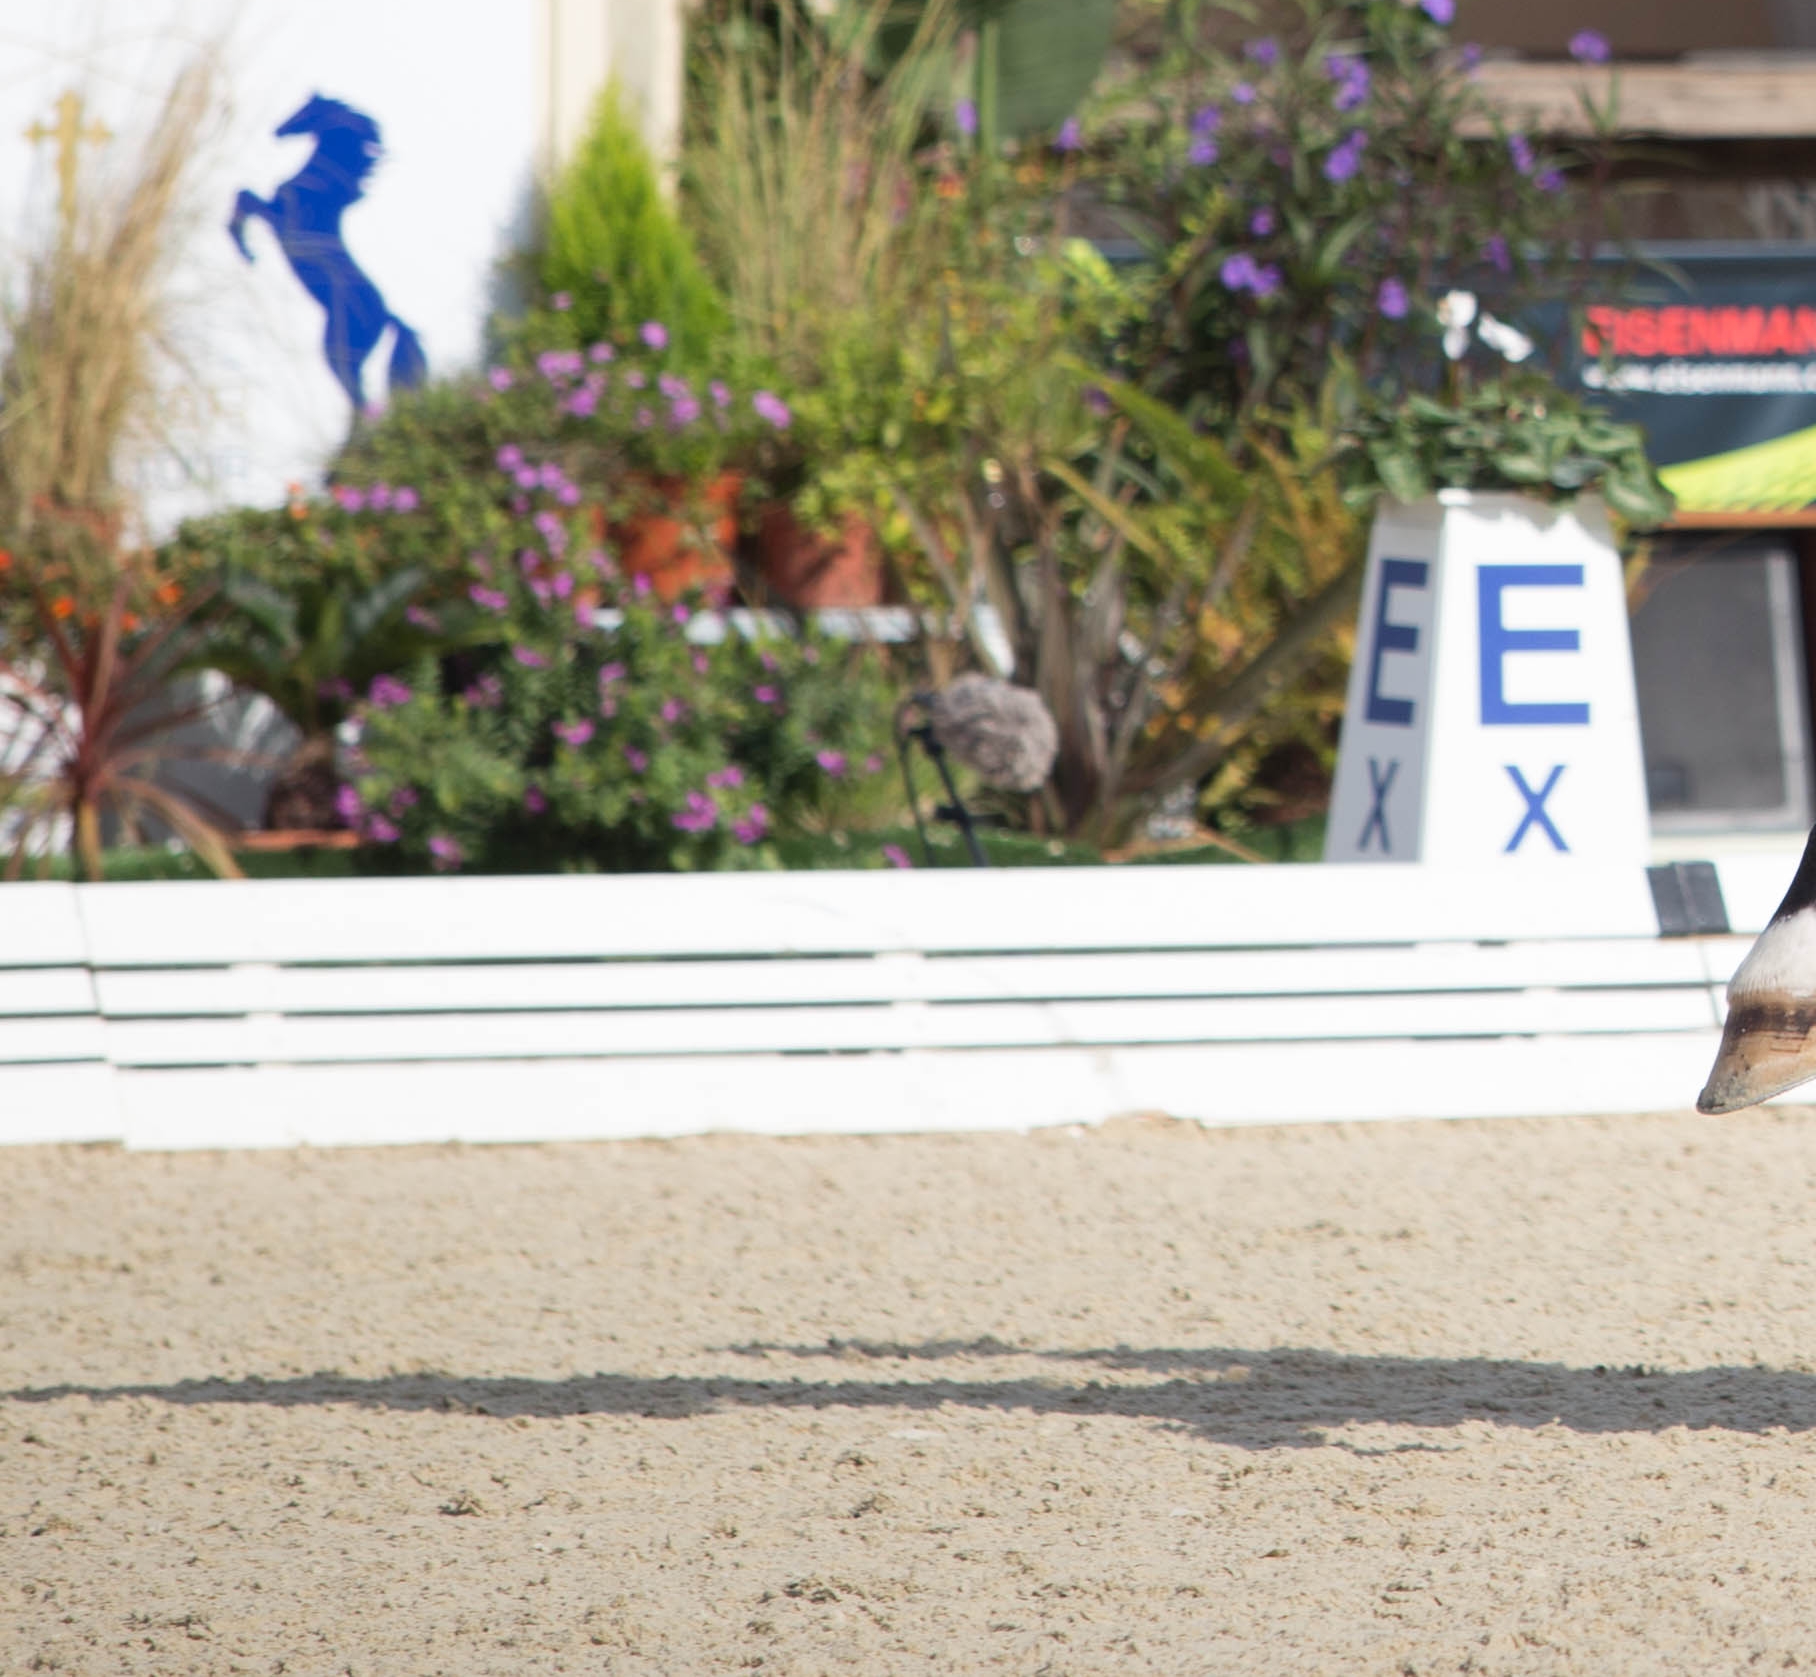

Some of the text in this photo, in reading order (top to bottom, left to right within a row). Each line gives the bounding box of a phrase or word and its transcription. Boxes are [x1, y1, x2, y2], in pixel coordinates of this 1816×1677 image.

[1364, 558, 1429, 727] E
[1476, 564, 1591, 726] E
[1357, 756, 1401, 852] X
[1504, 764, 1570, 853] X
